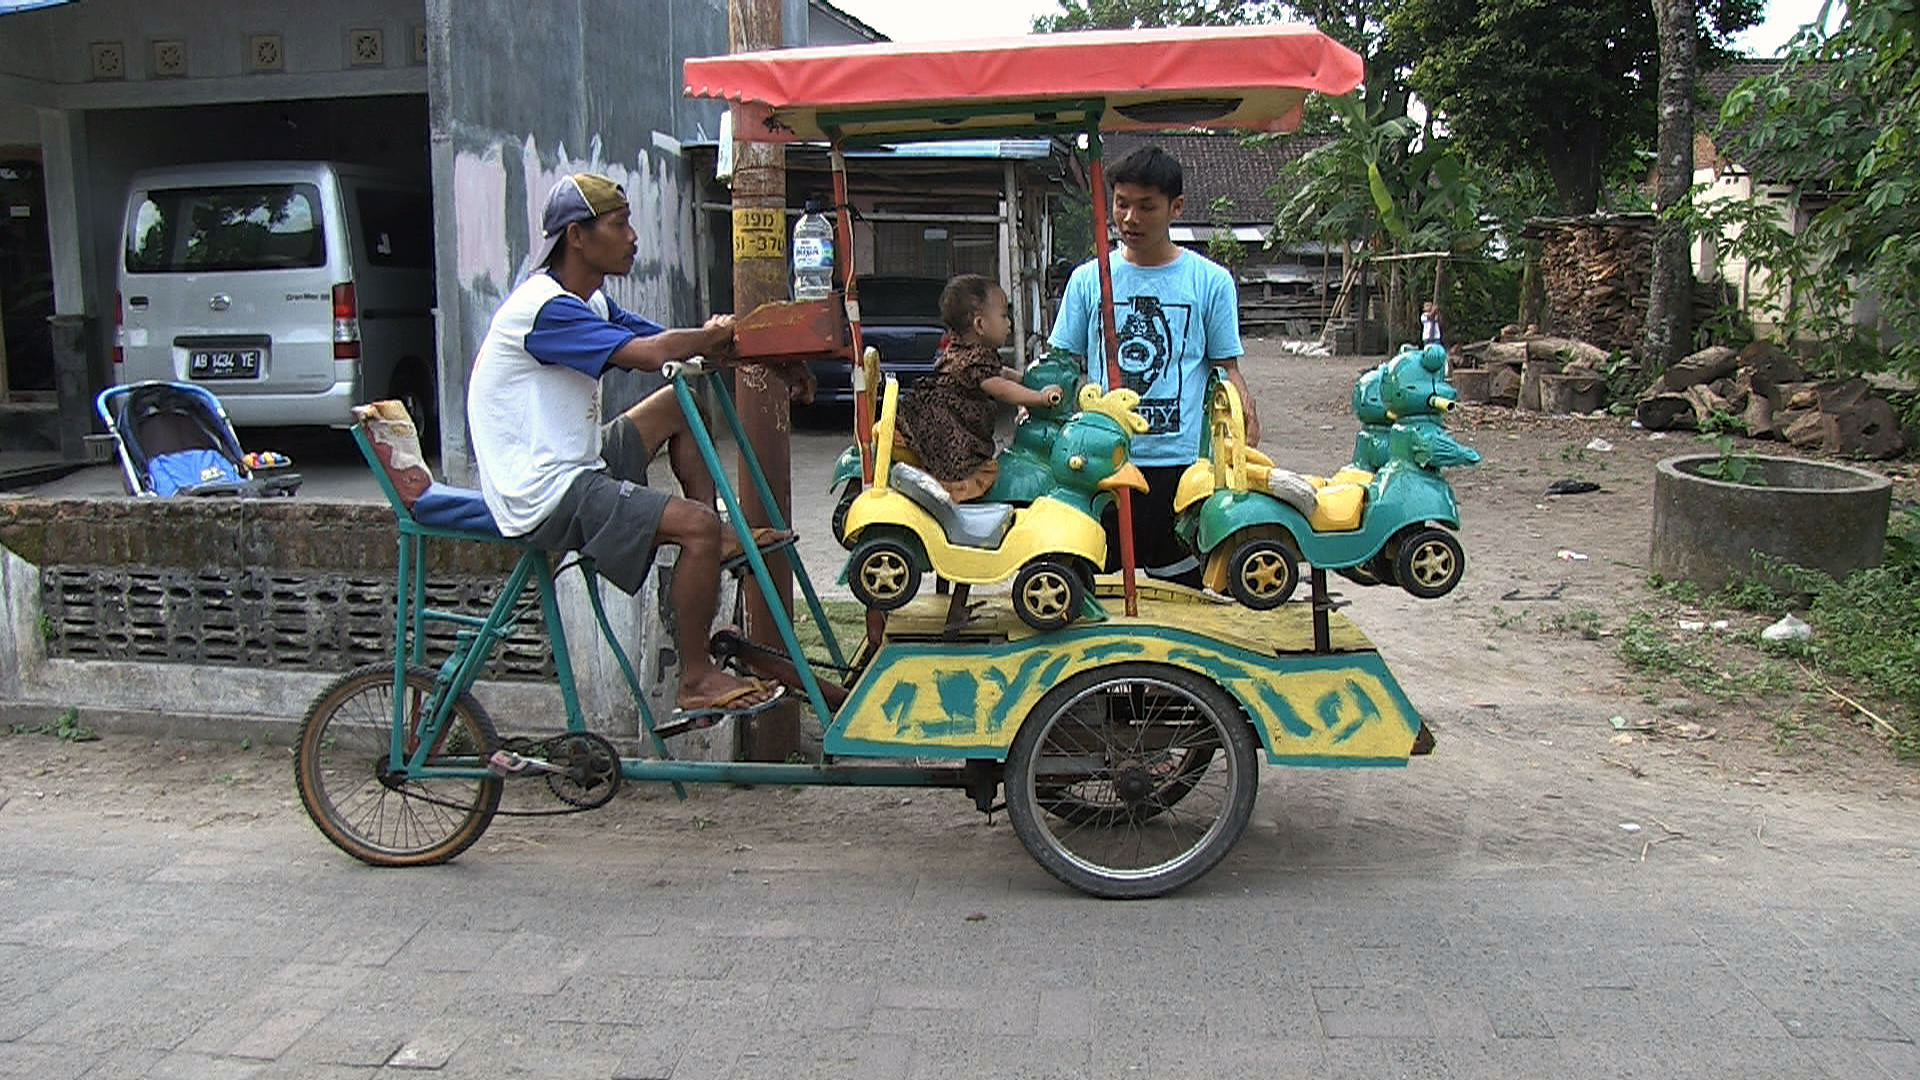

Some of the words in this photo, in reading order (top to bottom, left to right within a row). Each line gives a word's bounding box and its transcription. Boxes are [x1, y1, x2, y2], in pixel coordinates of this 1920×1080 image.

[194, 353, 208, 369] AB
[212, 353, 235, 368] 1434
[241, 351, 255, 367] YE
[1136, 405, 1179, 427] EY
